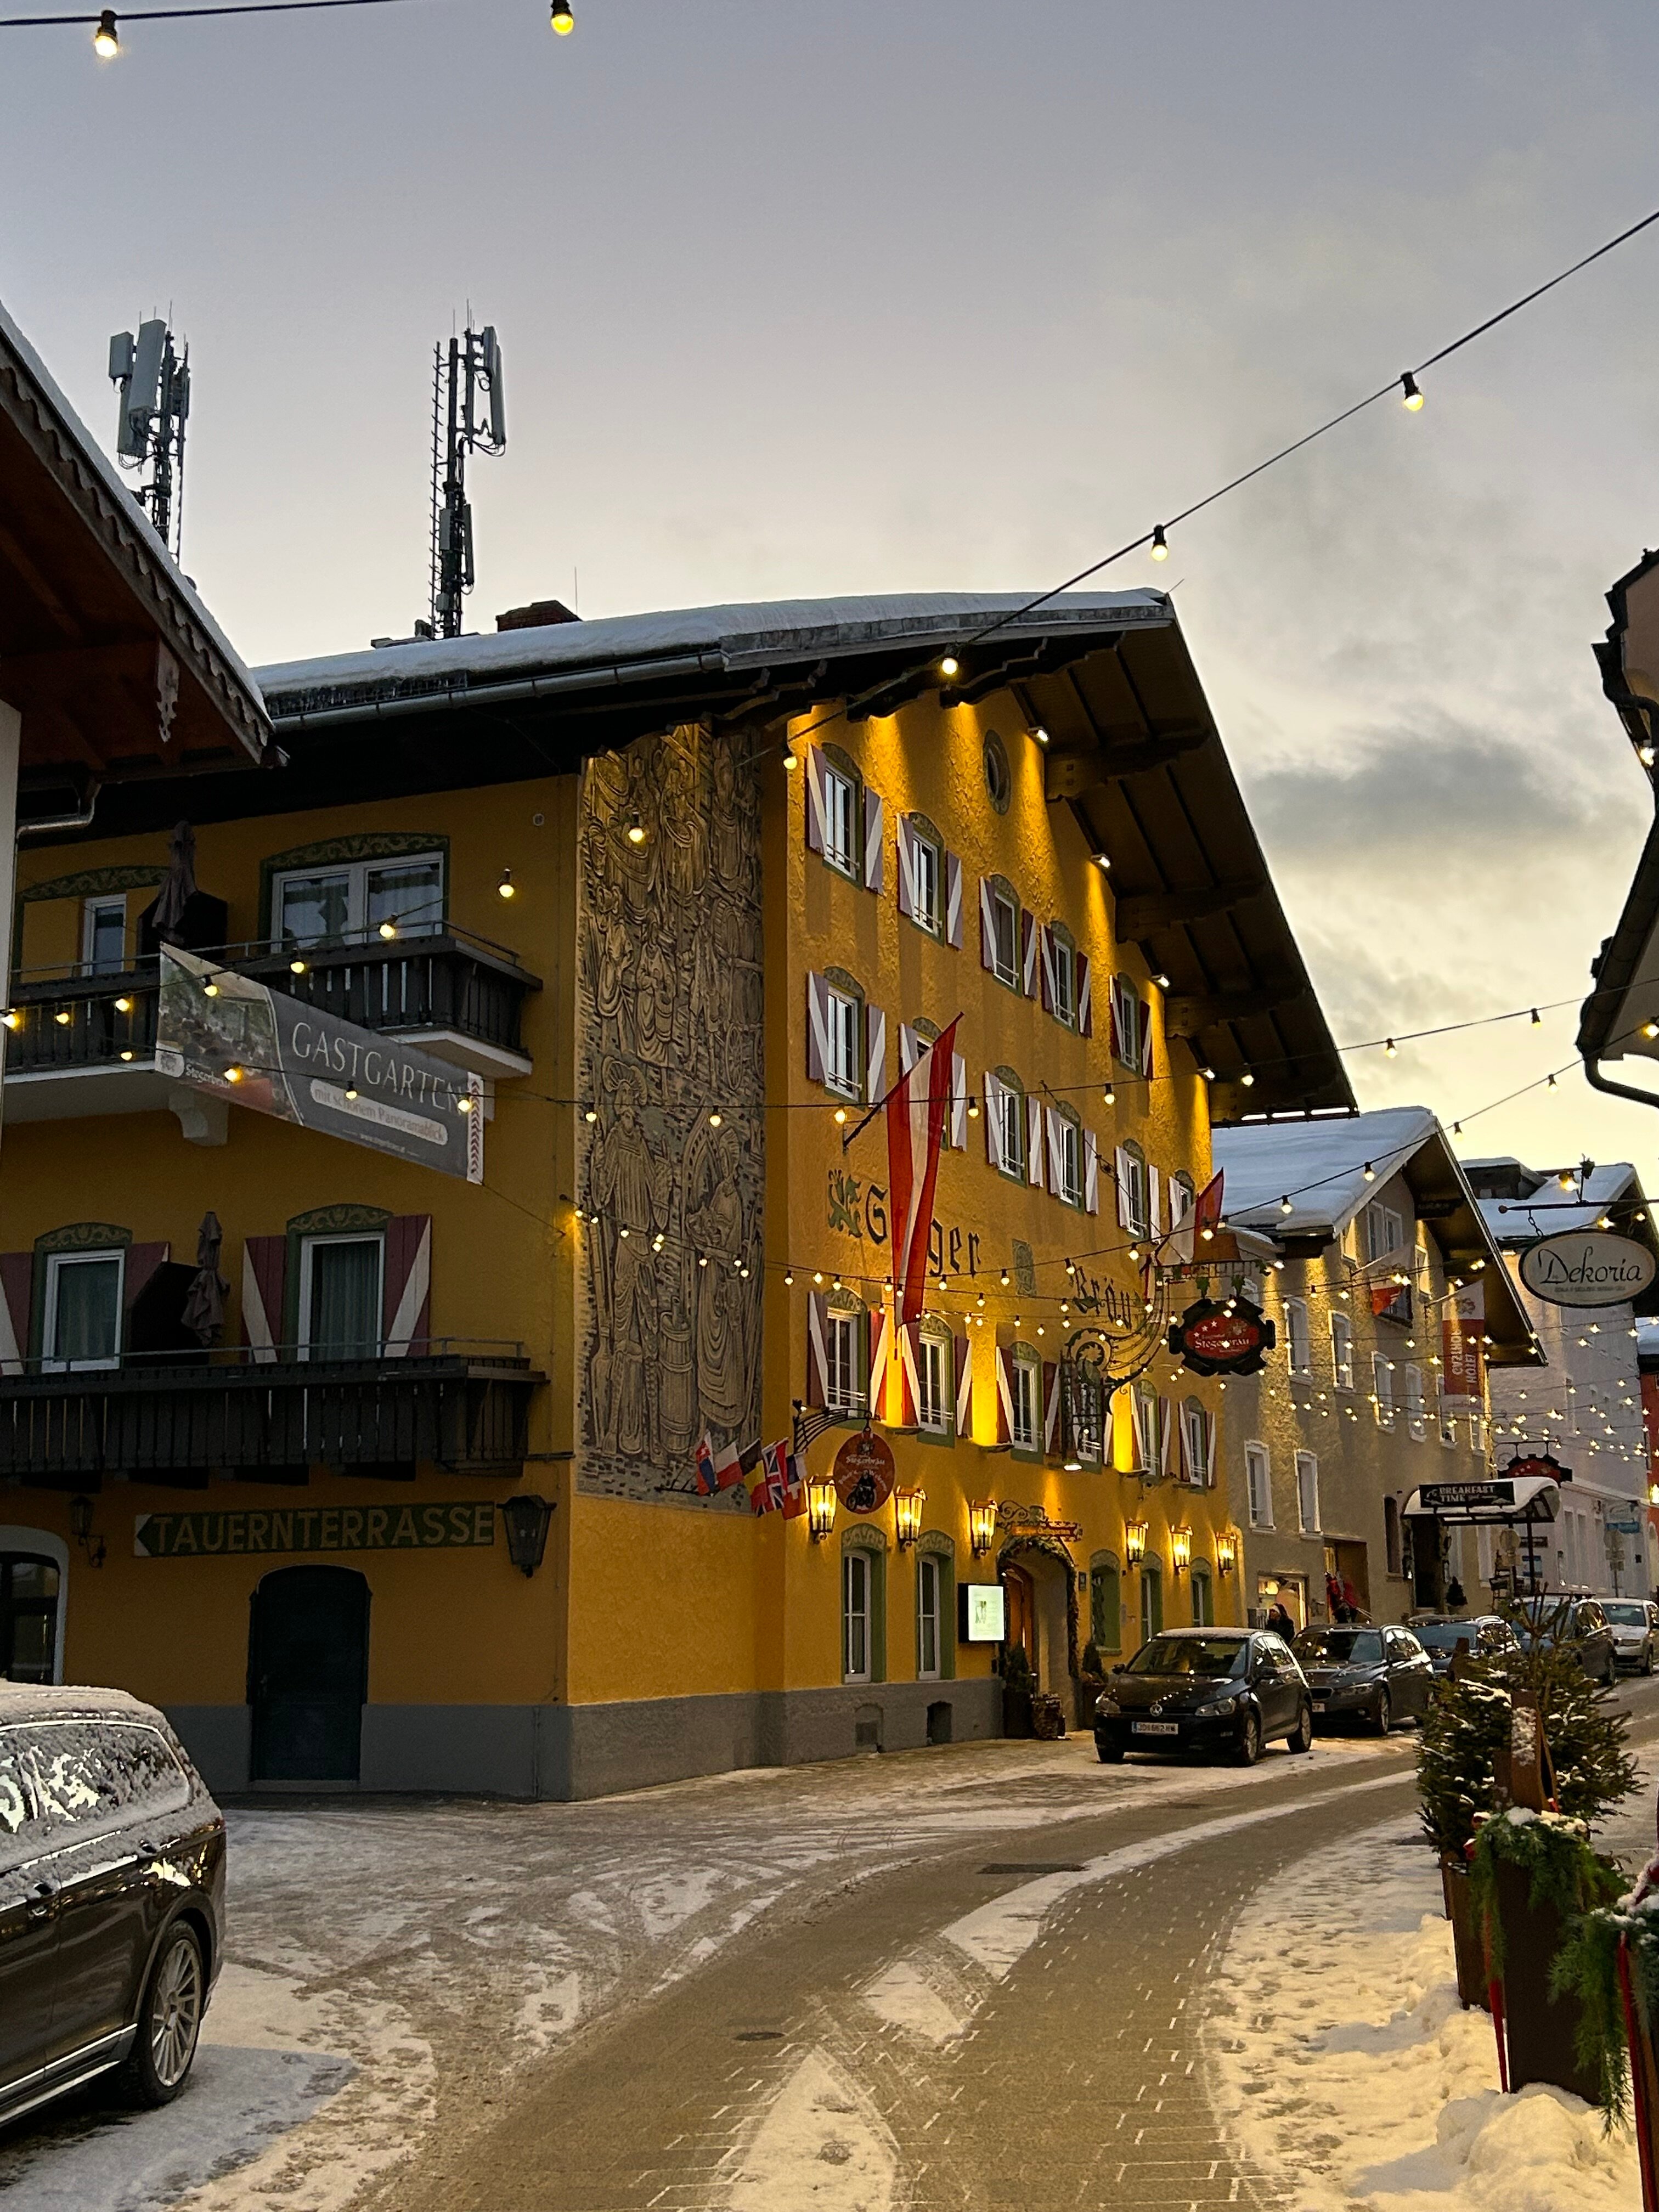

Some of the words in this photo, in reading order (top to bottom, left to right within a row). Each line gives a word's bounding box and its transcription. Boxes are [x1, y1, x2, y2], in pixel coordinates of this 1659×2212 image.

[291, 1022, 462, 1115] GASTGARTEN
[1537, 1246, 1643, 1285] Dekoria
[1439, 1485, 1496, 1494] BREAKFAST
[1441, 1494, 1466, 1503] TIME
[153, 1505, 494, 1553] TAUERNTERRASSE
